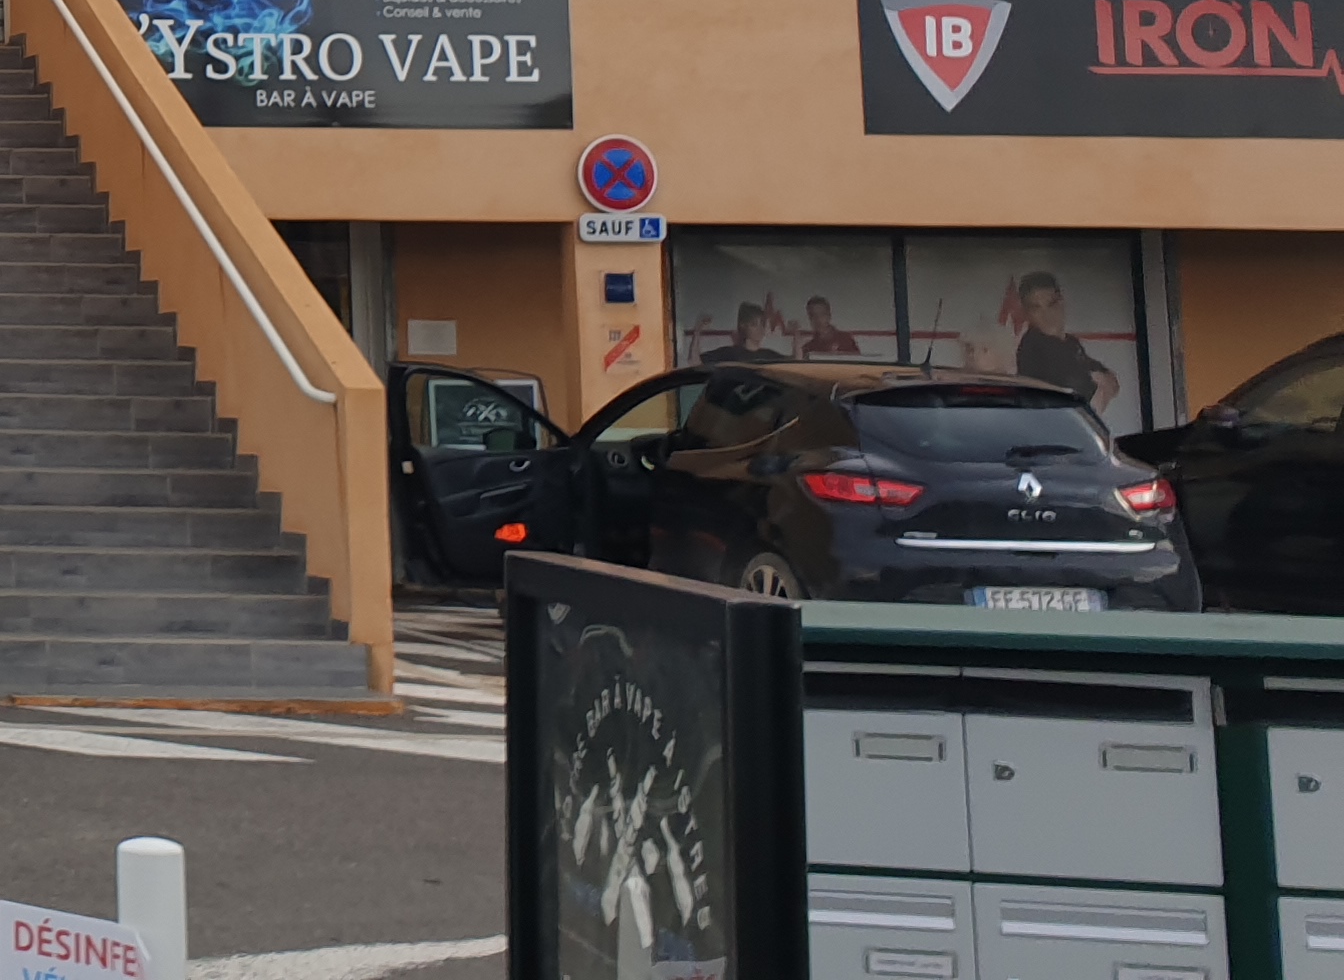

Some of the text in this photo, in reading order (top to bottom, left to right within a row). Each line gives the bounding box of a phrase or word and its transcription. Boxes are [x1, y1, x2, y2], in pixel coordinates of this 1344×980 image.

[383, 5, 482, 18] Conseil & vente
[924, 15, 974, 58] IB
[378, 33, 541, 83] VAPE
[256, 85, 376, 108] BAR À VAPE
[586, 219, 634, 237] SAUF
[586, 688, 610, 738] BAR
[625, 681, 663, 740] VAPE
